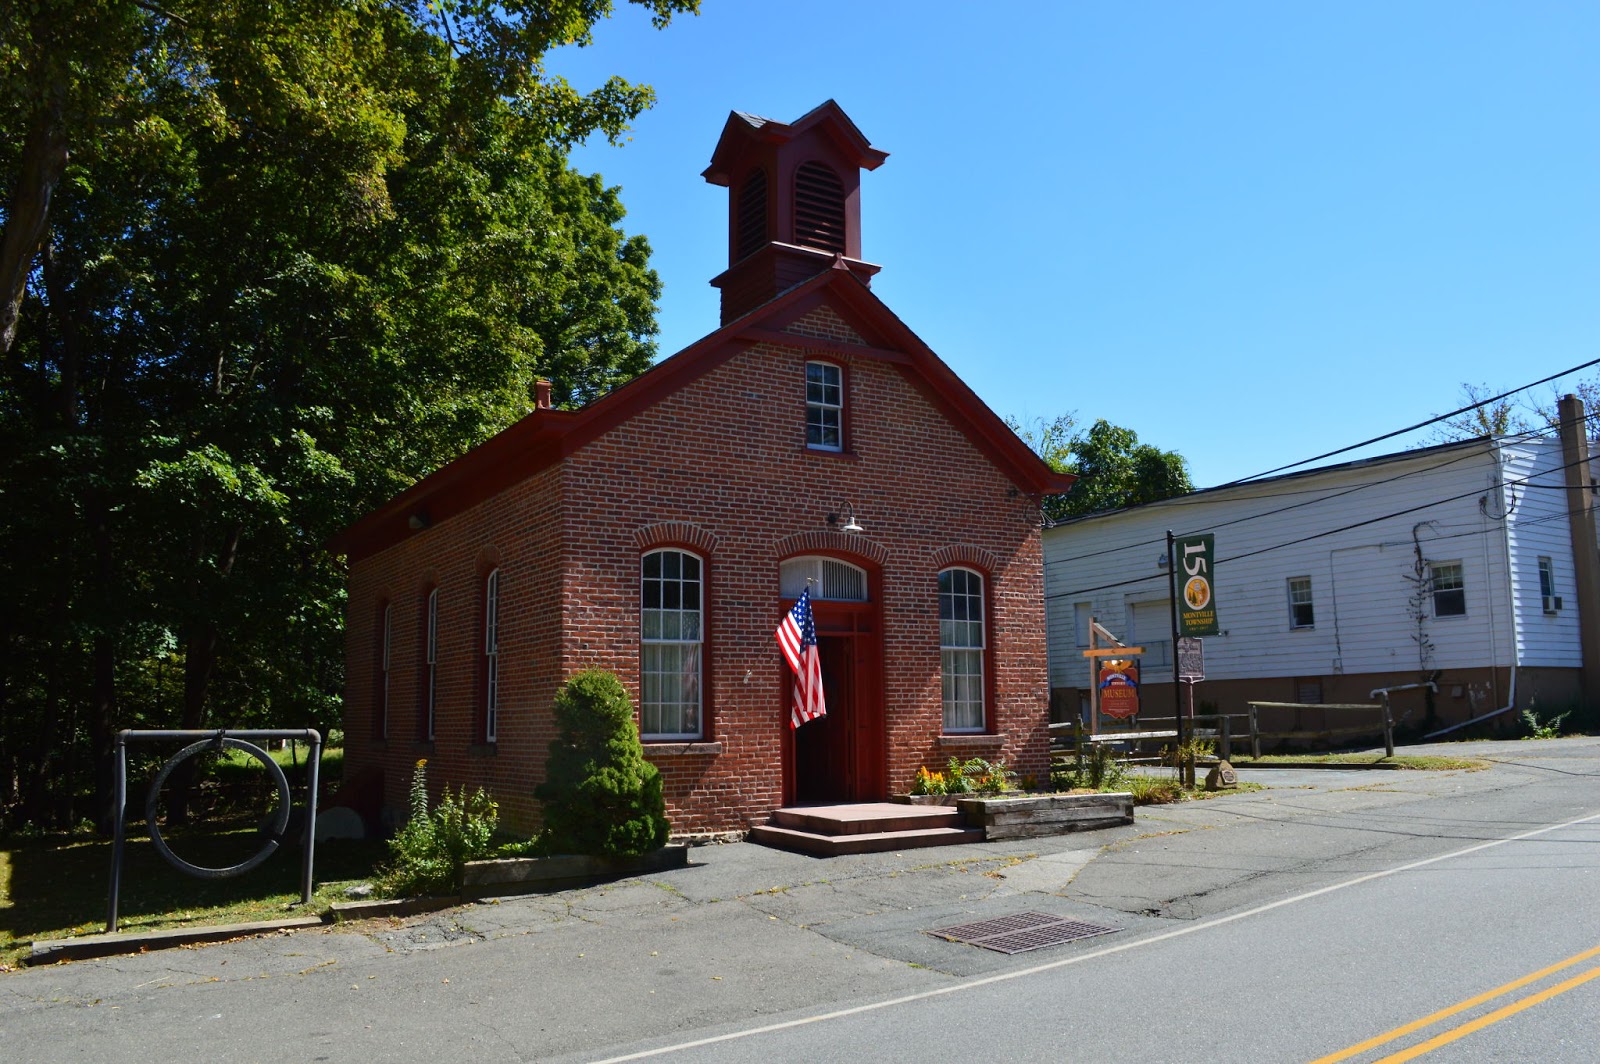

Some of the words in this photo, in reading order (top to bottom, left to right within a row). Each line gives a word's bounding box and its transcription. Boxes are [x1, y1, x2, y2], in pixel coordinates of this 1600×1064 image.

[1183, 610, 1214, 618] MONTVILLE
[1185, 617, 1213, 625] TOWNSHIP
[1103, 689, 1135, 698] MUSEUM
